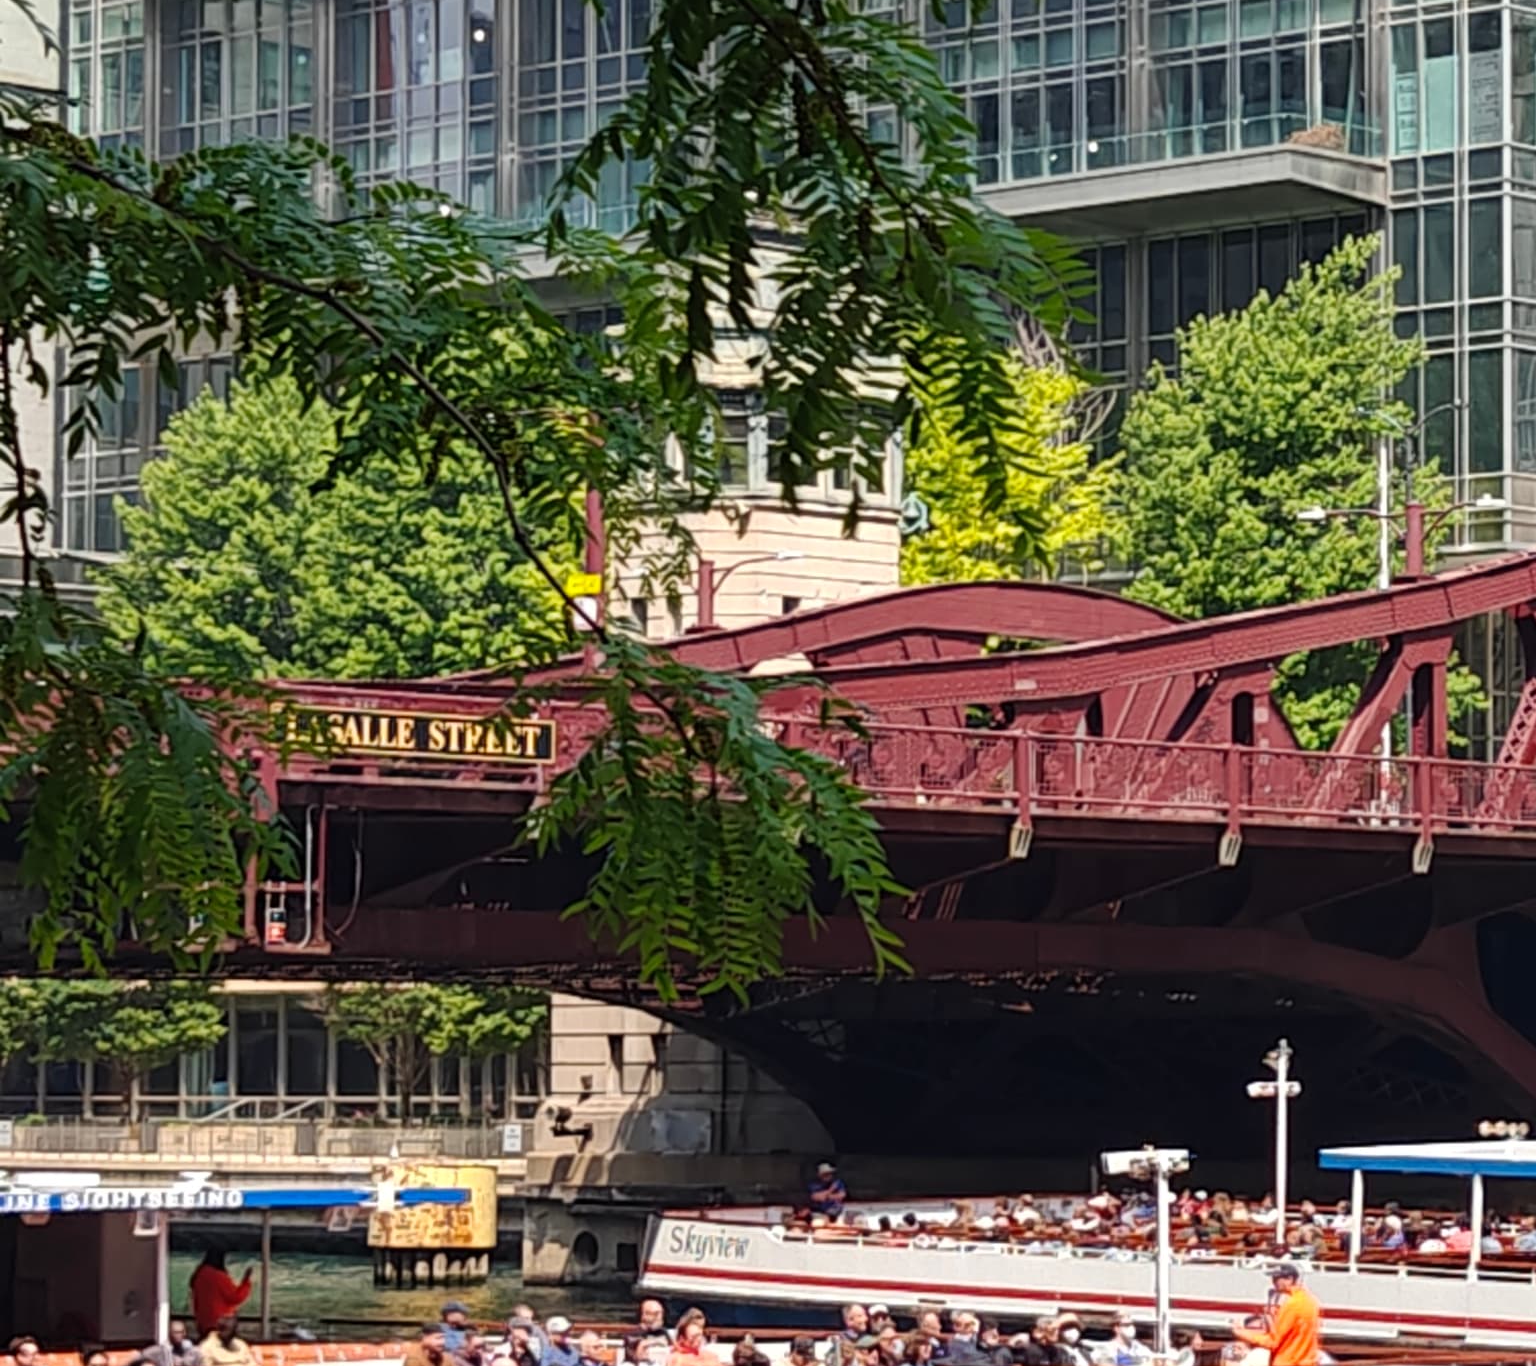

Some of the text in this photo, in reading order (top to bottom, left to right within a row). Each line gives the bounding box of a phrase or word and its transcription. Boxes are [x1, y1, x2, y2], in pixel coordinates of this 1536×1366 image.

[286, 713, 542, 757] LASALLE STREET
[669, 1224, 750, 1263] Skyview
